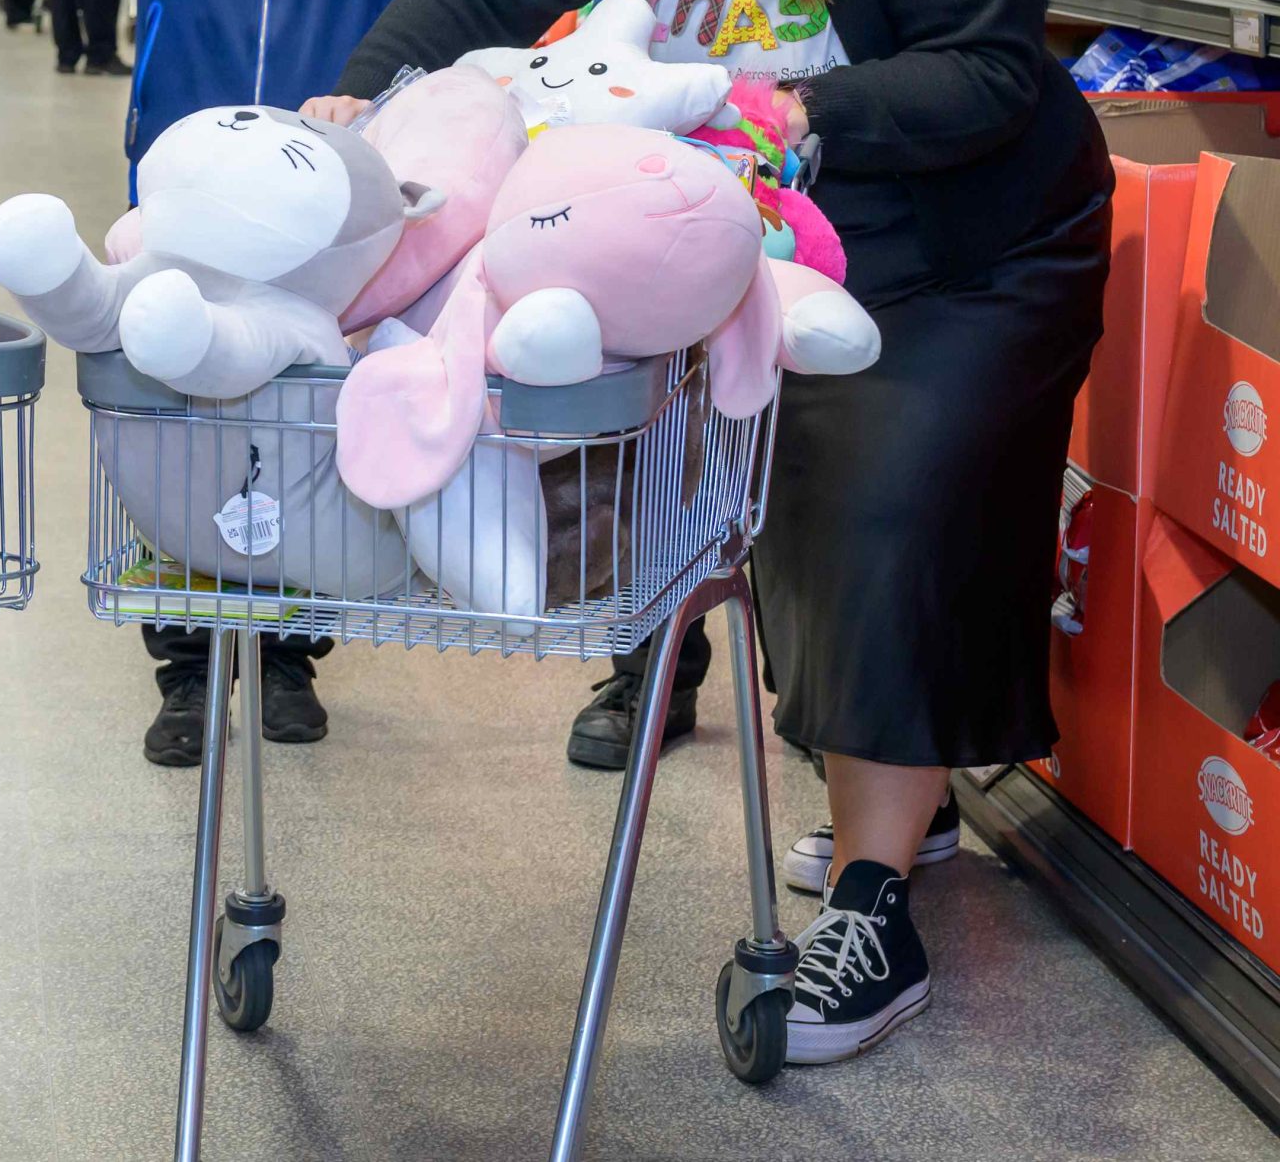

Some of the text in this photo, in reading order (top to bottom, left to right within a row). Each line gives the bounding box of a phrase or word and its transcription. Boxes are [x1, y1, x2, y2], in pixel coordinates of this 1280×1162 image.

[735, 67, 777, 80] Across
[780, 56, 838, 80] Scotland
[1223, 400, 1268, 441] SNACKRITE
[1219, 461, 1266, 515] READY
[1212, 505, 1267, 557] SALTED
[1197, 771, 1255, 825] SNACKRITE
[1200, 829, 1257, 898] READY
[1198, 864, 1264, 939] SALTED
